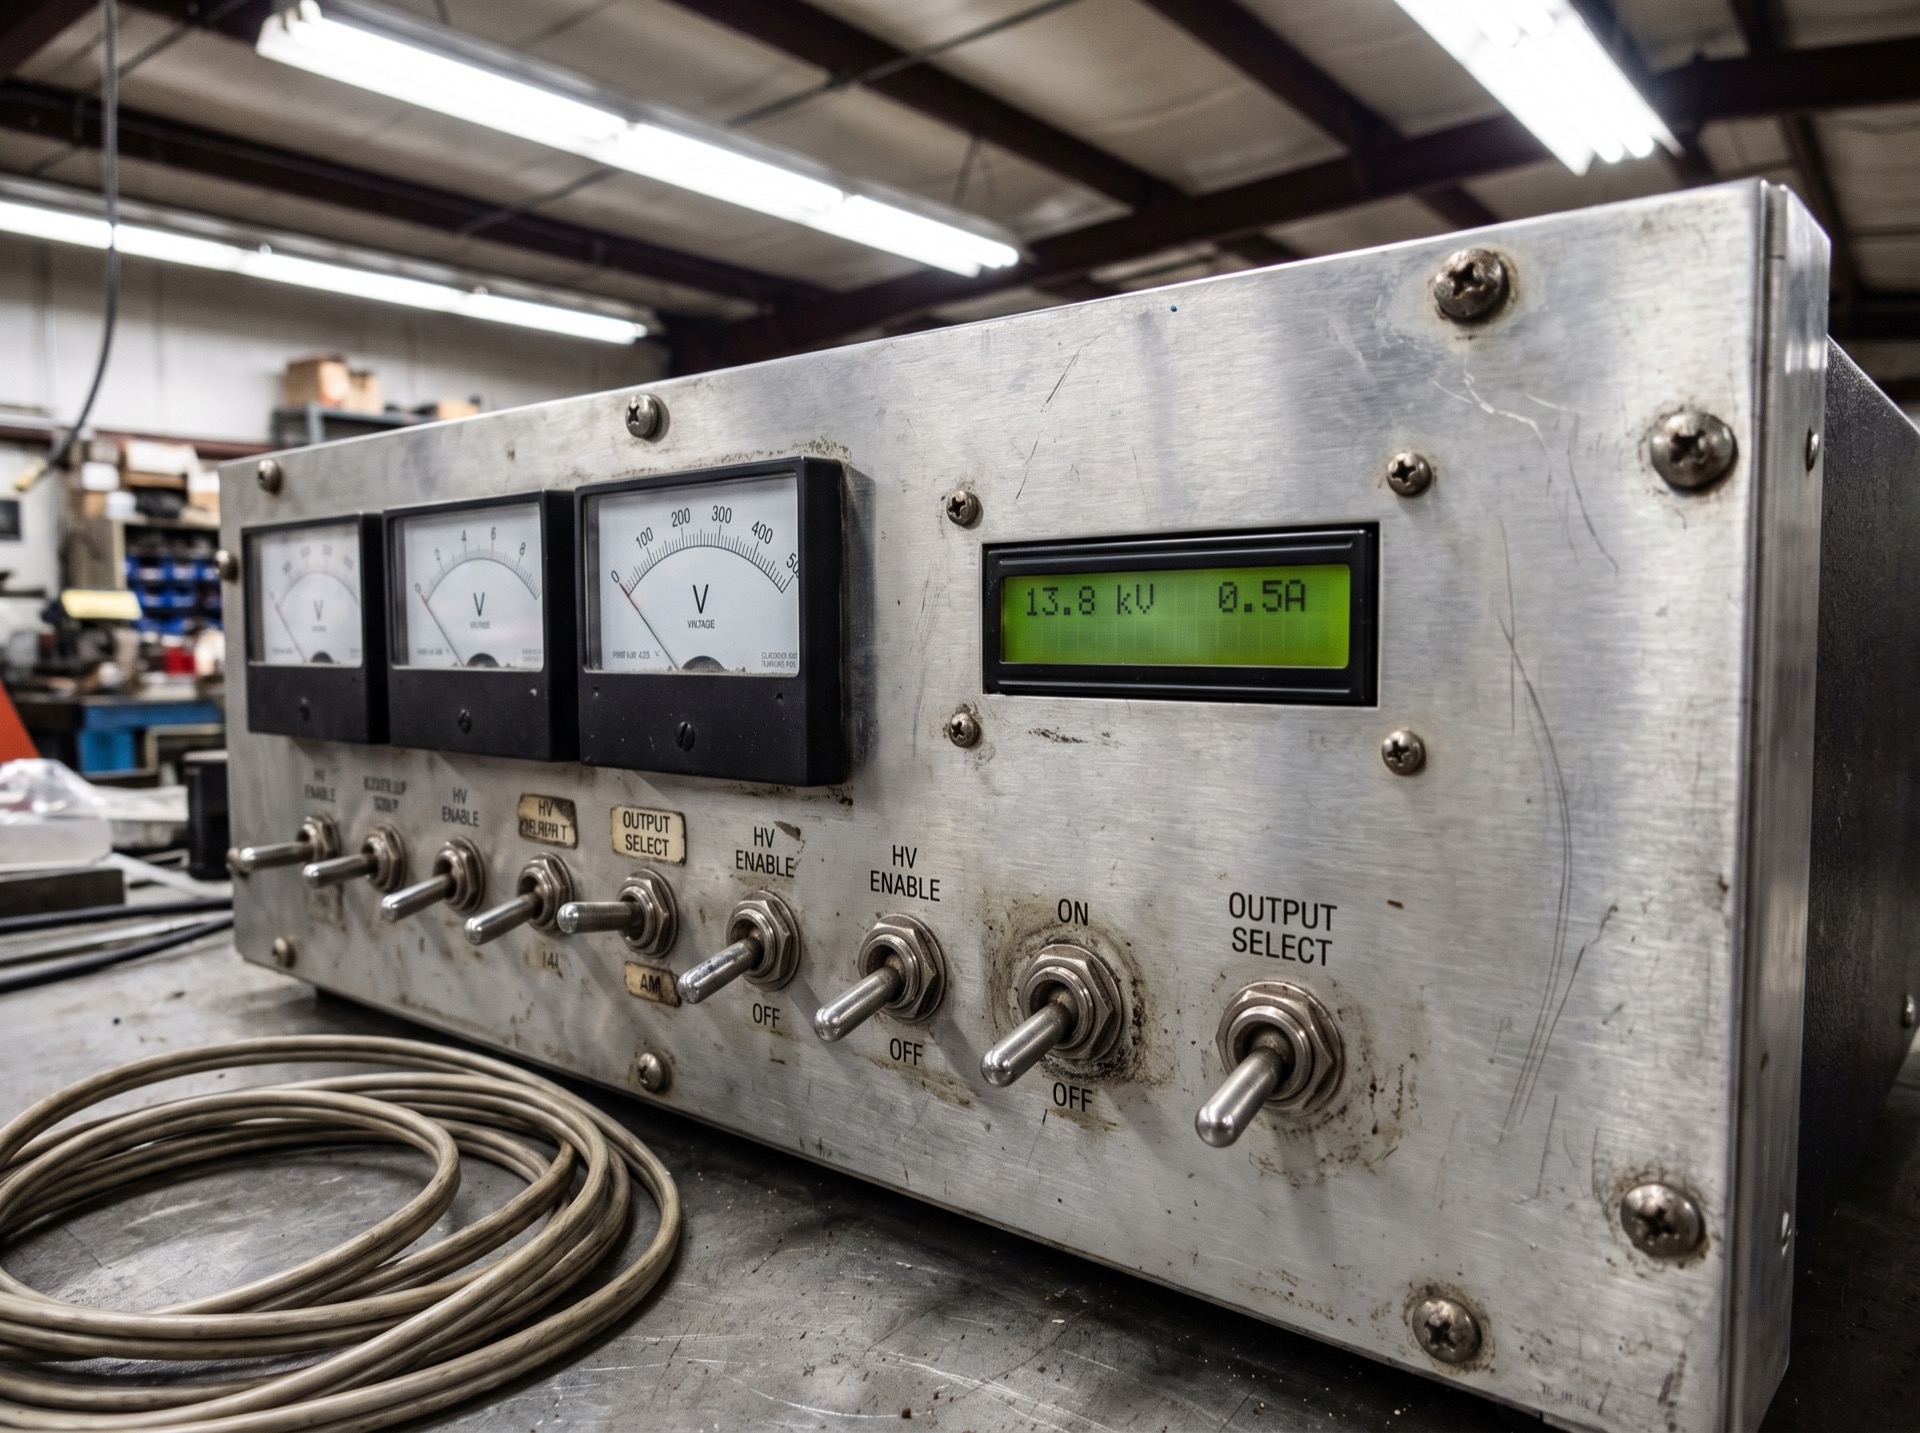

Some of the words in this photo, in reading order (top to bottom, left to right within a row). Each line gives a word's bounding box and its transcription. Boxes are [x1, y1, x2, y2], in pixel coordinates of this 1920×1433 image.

[461, 529, 467, 542] 4
[491, 526, 497, 541] 6
[519, 541, 526, 556] 8
[610, 570, 620, 584] 0
[635, 527, 654, 550] 100
[671, 507, 691, 528] 200
[711, 505, 732, 524] 300
[751, 521, 773, 545] 400
[473, 592, 485, 617] V
[692, 584, 709, 614] V
[1027, 585, 1096, 617] 13.8
[1117, 583, 1154, 615] kV
[1218, 579, 1306, 613] 0.5A
[453, 787, 468, 804] HV
[538, 800, 554, 817] HV
[442, 806, 479, 827] ENABLE
[623, 811, 670, 834] OUTPUT
[625, 834, 670, 857] SELECT
[753, 826, 775, 848] HV
[735, 850, 795, 878] ENABLE
[892, 844, 917, 869] HV
[870, 870, 941, 902] ENABLE
[1057, 898, 1088, 926] ON
[1229, 892, 1338, 931] OUTPUT
[1232, 927, 1333, 966] SELECT
[752, 1003, 781, 1028] OFF
[889, 1037, 923, 1066] OFF
[1053, 1081, 1093, 1112] OFF
